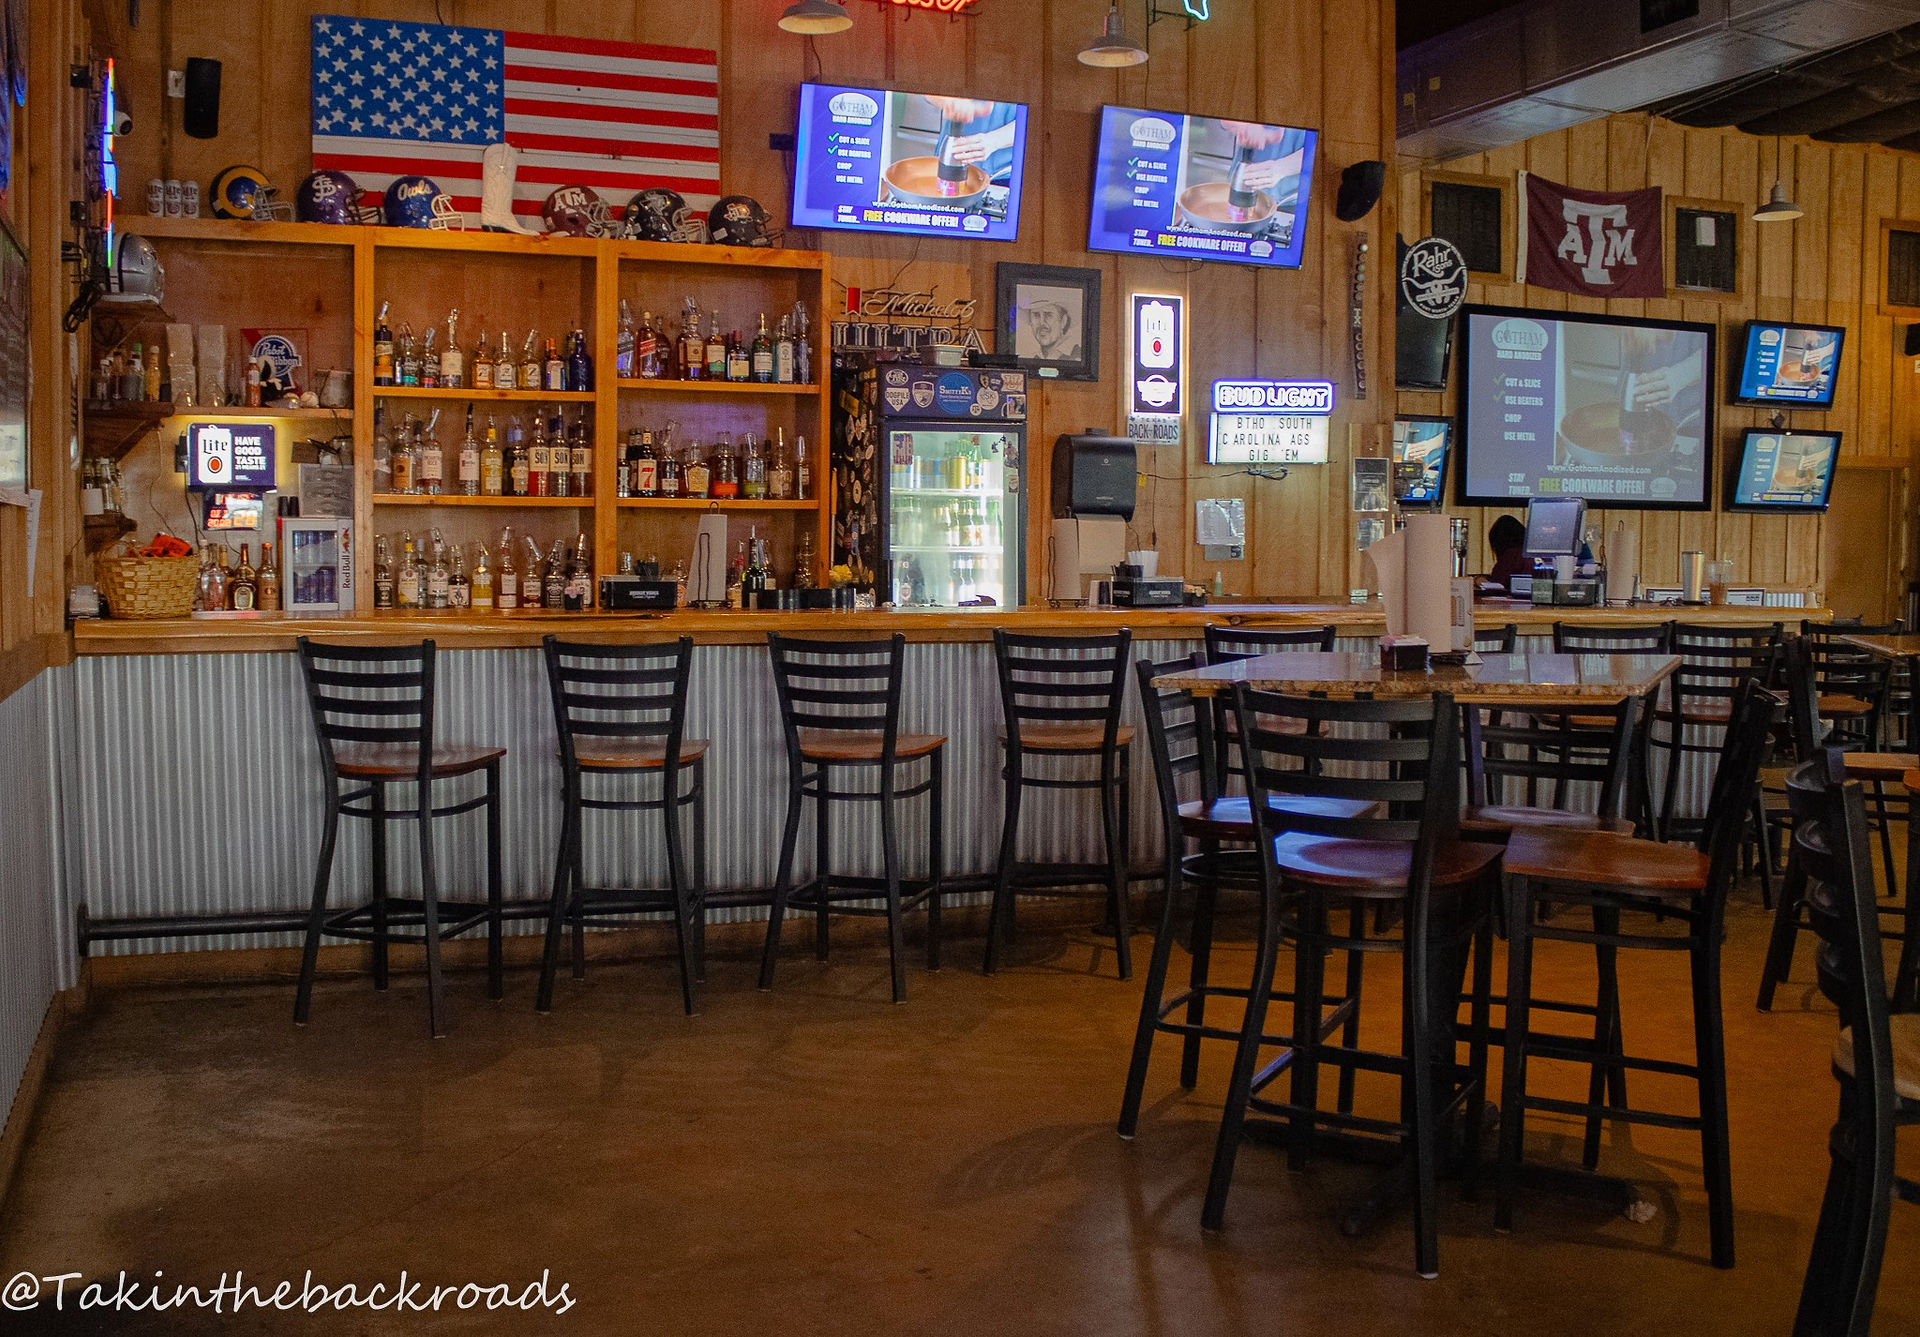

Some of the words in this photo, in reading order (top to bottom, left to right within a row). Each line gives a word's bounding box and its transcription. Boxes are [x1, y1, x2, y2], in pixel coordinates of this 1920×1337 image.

[832, 101, 873, 116] GOTHAM
[1134, 124, 1172, 139] GOTHAM
[872, 199, 966, 213] www.GothamAnodized.com
[864, 210, 883, 222] FREE
[884, 212, 931, 226] COOKWARE
[931, 215, 959, 228] OFFER!
[1166, 224, 1253, 239] www.GothamAnodized.com
[1157, 234, 1176, 246] FREE
[1176, 236, 1220, 250] COOKWARE
[1220, 239, 1246, 252] OFFER!
[1412, 246, 1451, 278] Rahr
[864, 290, 977, 320] Michelob
[1496, 330, 1543, 347] GOTHAM
[261, 342, 286, 356] Pabst
[1505, 378, 1518, 387] CUT
[1525, 379, 1541, 388] SLICE
[1220, 386, 1266, 406] BUD
[1266, 387, 1329, 407] LIGHT
[1505, 396, 1517, 405] USE
[1518, 396, 1543, 406] BEATERS
[1237, 417, 1265, 429] BTHO
[1280, 417, 1312, 429] SOUTH
[1128, 424, 1150, 439] BACK
[1153, 425, 1178, 440] ROADS
[1290, 433, 1310, 445] AGS
[1504, 432, 1516, 440] USE
[1517, 432, 1536, 441] METAL
[203, 439, 228, 455] Lite
[234, 436, 261, 445] HAVE
[234, 446, 262, 455] GOOD
[1249, 450, 1269, 461] GIG
[234, 456, 266, 465] TASTE
[1547, 464, 1651, 474] www.GothamAnodized.com
[642, 467, 654, 488] 7
[1508, 473, 1525, 483] STAY
[1539, 477, 1561, 492] FREE
[1562, 478, 1615, 494] COOKWARE
[1616, 480, 1645, 494] OFFER!
